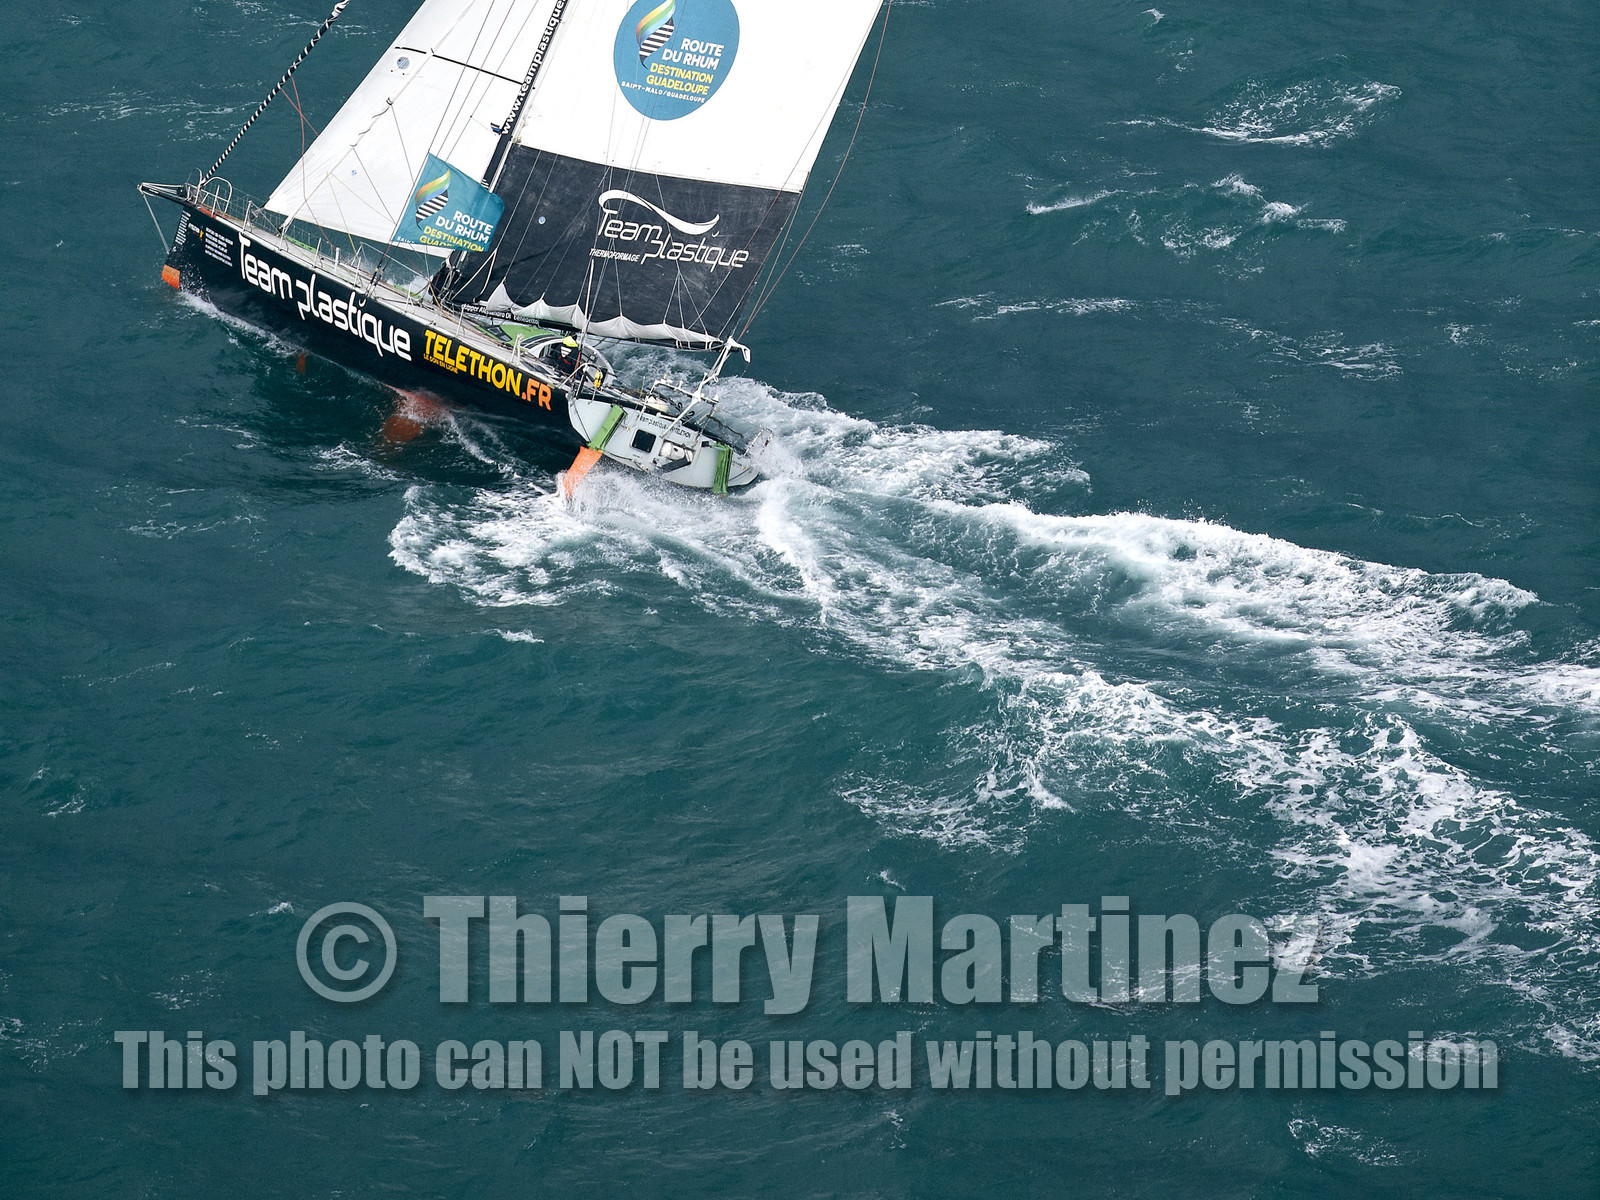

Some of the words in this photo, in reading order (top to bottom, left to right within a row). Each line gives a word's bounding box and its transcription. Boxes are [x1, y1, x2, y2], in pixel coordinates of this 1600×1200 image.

[662, 48, 682, 63] DU
[682, 53, 719, 70] RHUM
[681, 37, 725, 57] ROUTE
[646, 74, 710, 95] GUADELOUPE
[650, 62, 714, 84] DESTINATION
[435, 216, 454, 231] DU
[454, 224, 490, 244] RHUM
[453, 210, 494, 236] ROUTE
[598, 208, 662, 242] Team
[423, 225, 484, 252] DESTINATION
[589, 248, 640, 262] THERMOFORMAGE
[238, 231, 293, 300] Team
[296, 273, 412, 361] plastique
